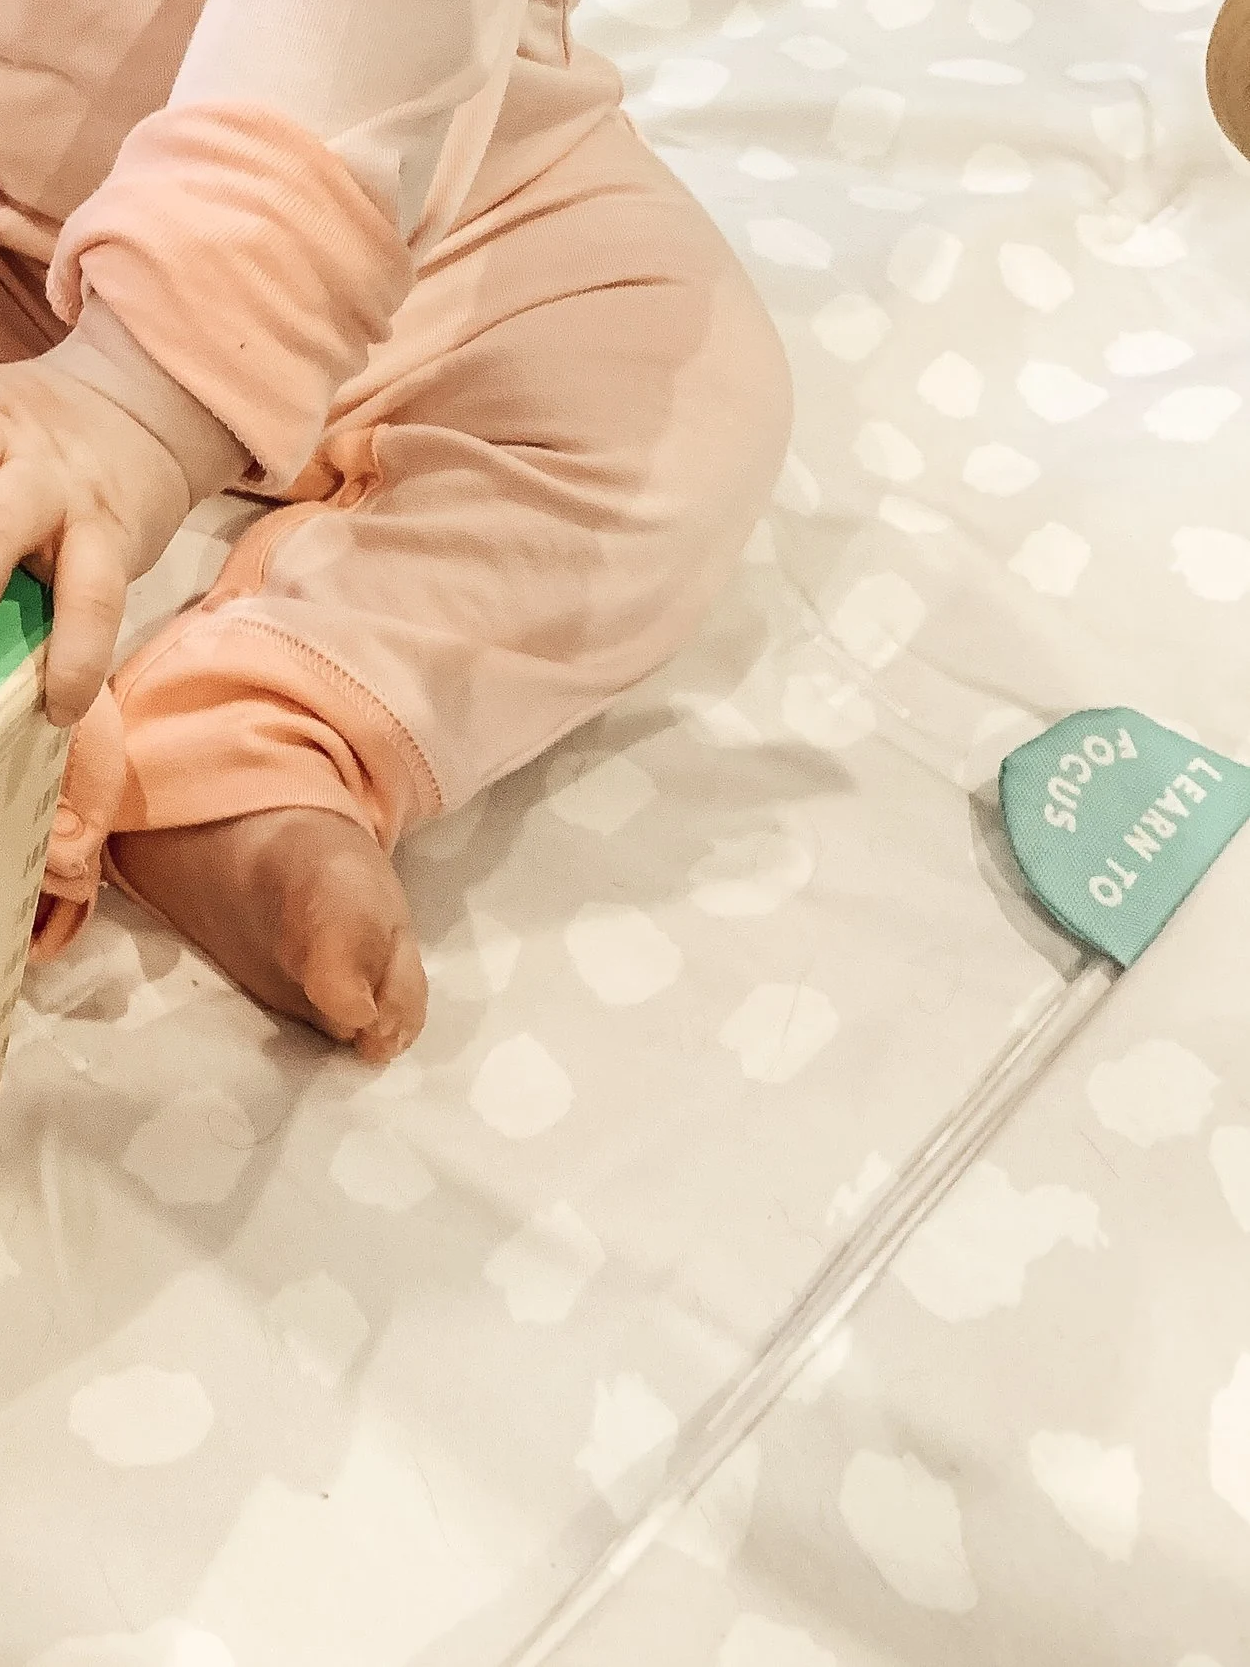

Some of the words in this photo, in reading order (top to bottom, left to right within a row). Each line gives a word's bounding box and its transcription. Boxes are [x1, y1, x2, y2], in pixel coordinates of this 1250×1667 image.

[1044, 728, 1137, 833] FOCUS
[1124, 757, 1222, 861] LEARN
[1088, 858, 1138, 907] TO
